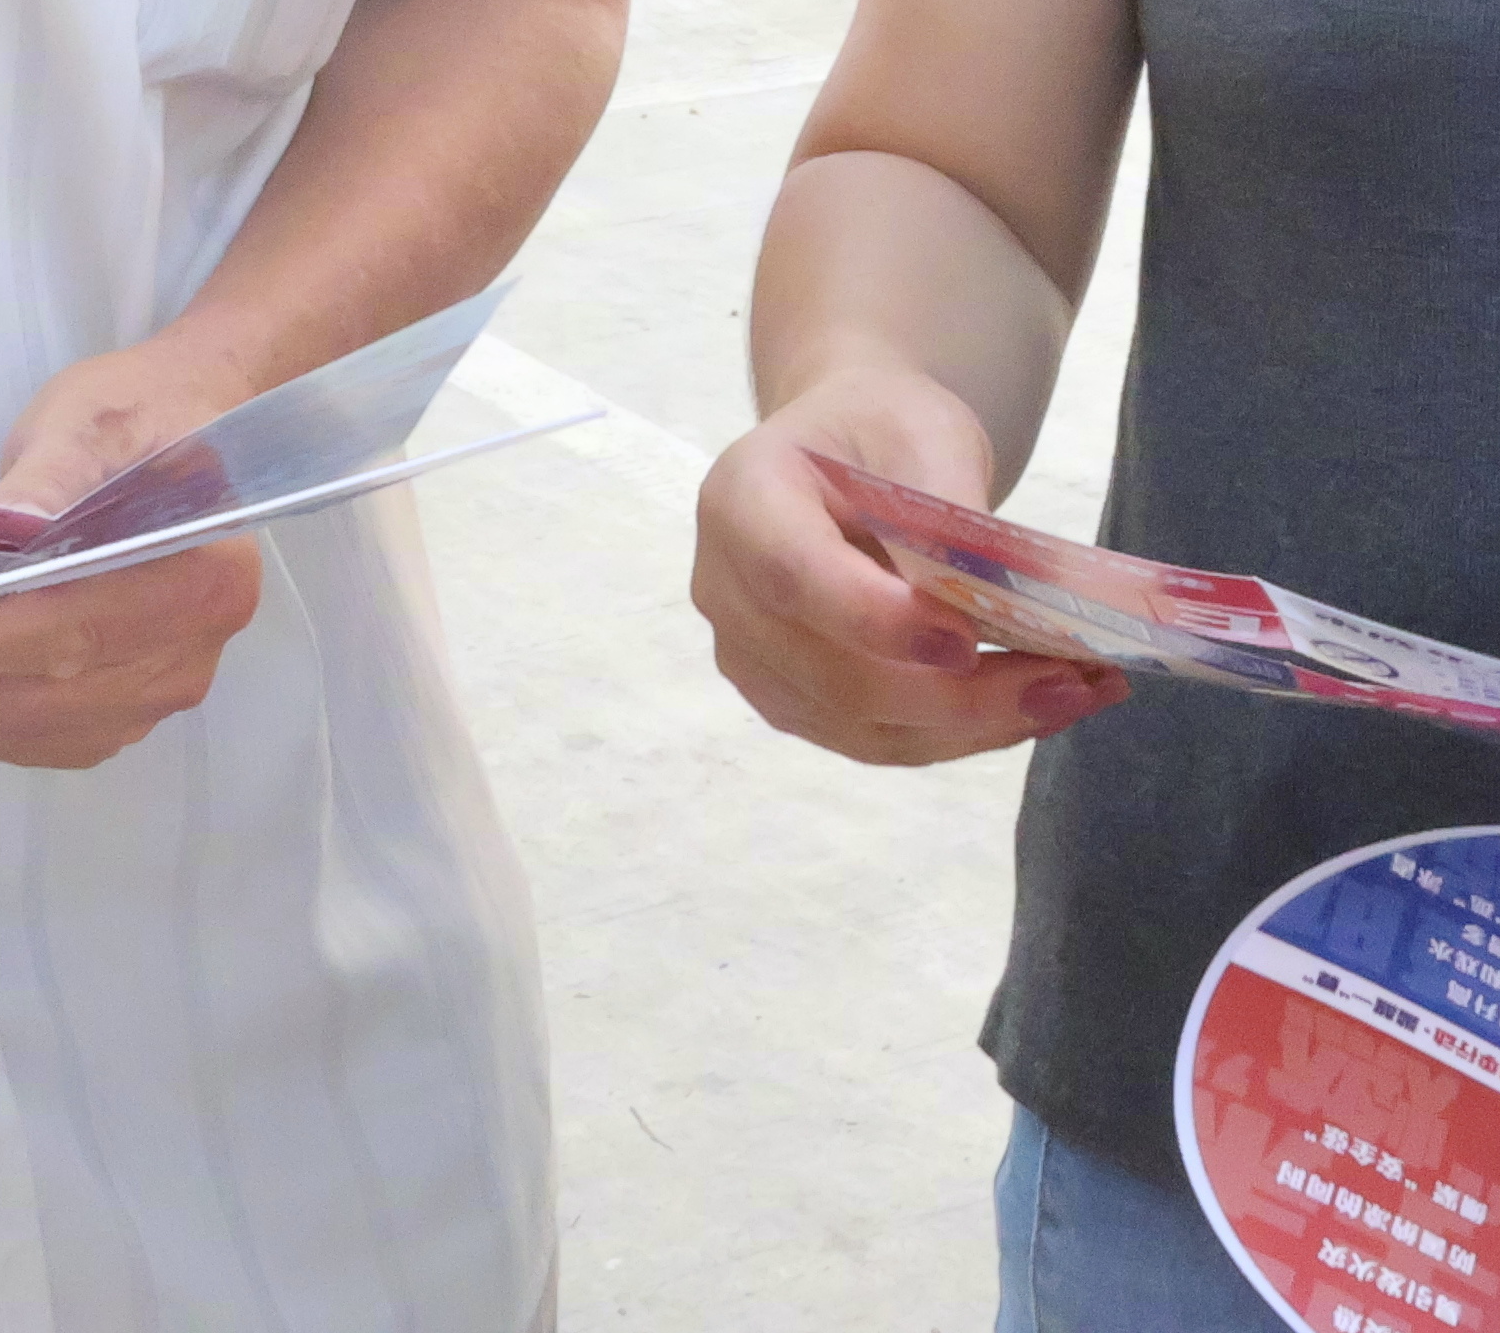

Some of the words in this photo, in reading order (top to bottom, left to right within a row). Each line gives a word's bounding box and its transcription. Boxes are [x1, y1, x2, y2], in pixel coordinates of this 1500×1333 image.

[1273, 1157, 1479, 1276] 防暑纳凉的同时
[1315, 1235, 1463, 1327] 易引发火灾
